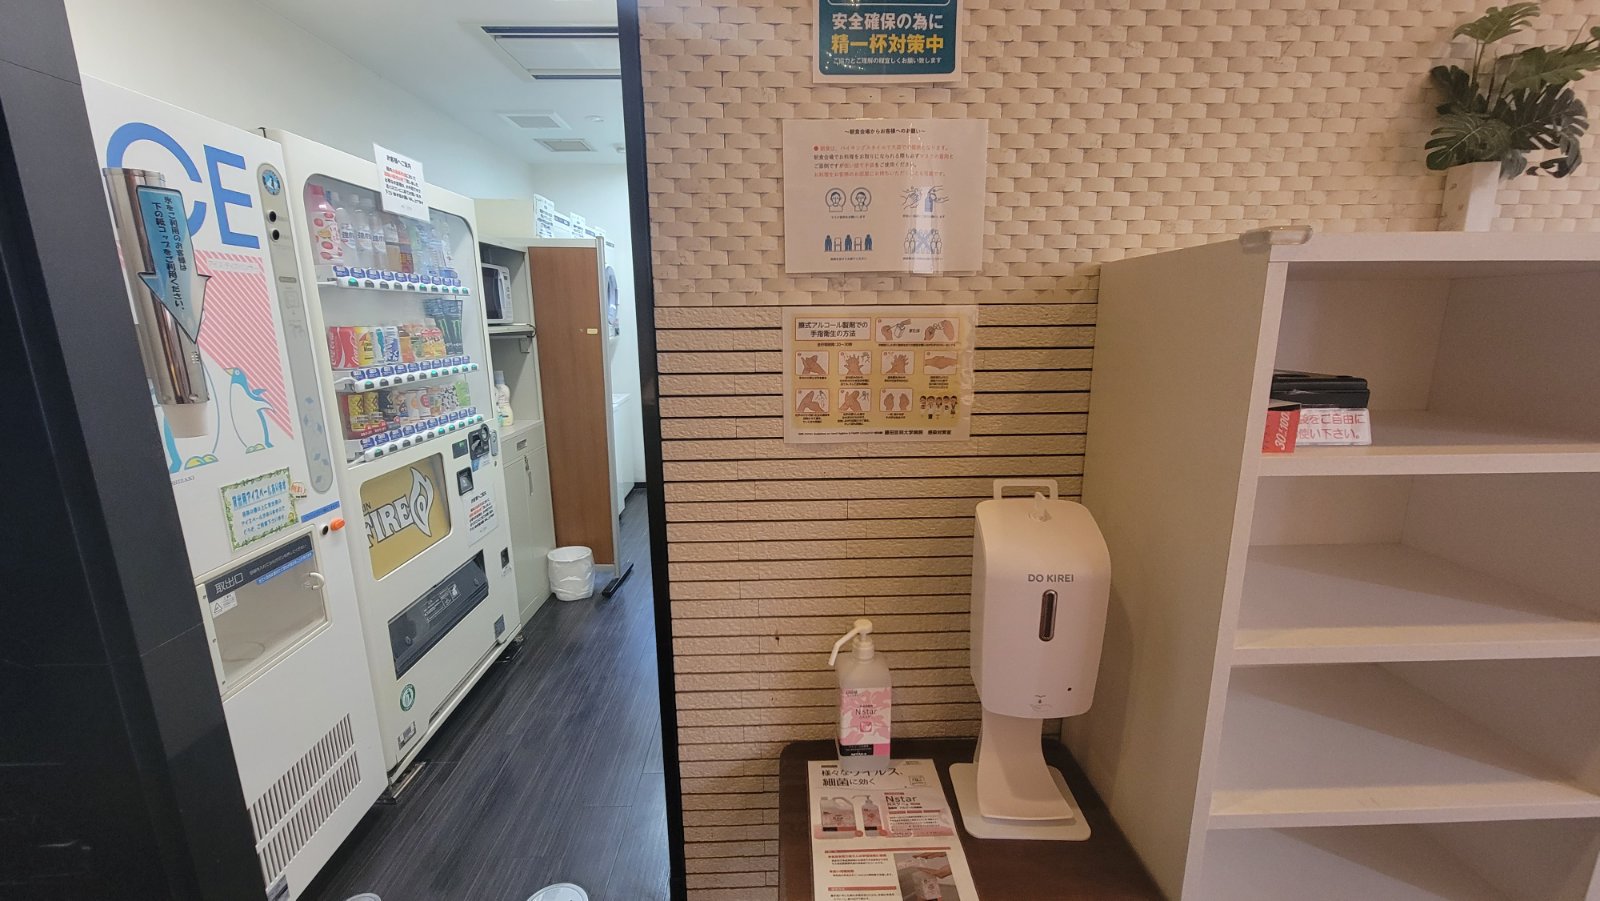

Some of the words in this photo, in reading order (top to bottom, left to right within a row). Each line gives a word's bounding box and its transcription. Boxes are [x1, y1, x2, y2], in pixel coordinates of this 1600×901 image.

[832, 12, 944, 30] 安全確保の為に
[831, 33, 944, 54] 精一杯対策中
[810, 330, 856, 338] 手指衛生の方法
[214, 572, 244, 595] 取出口
[1028, 574, 1044, 583] DO
[1046, 574, 1074, 583] KIREI
[822, 777, 876, 787] 細菌に効く
